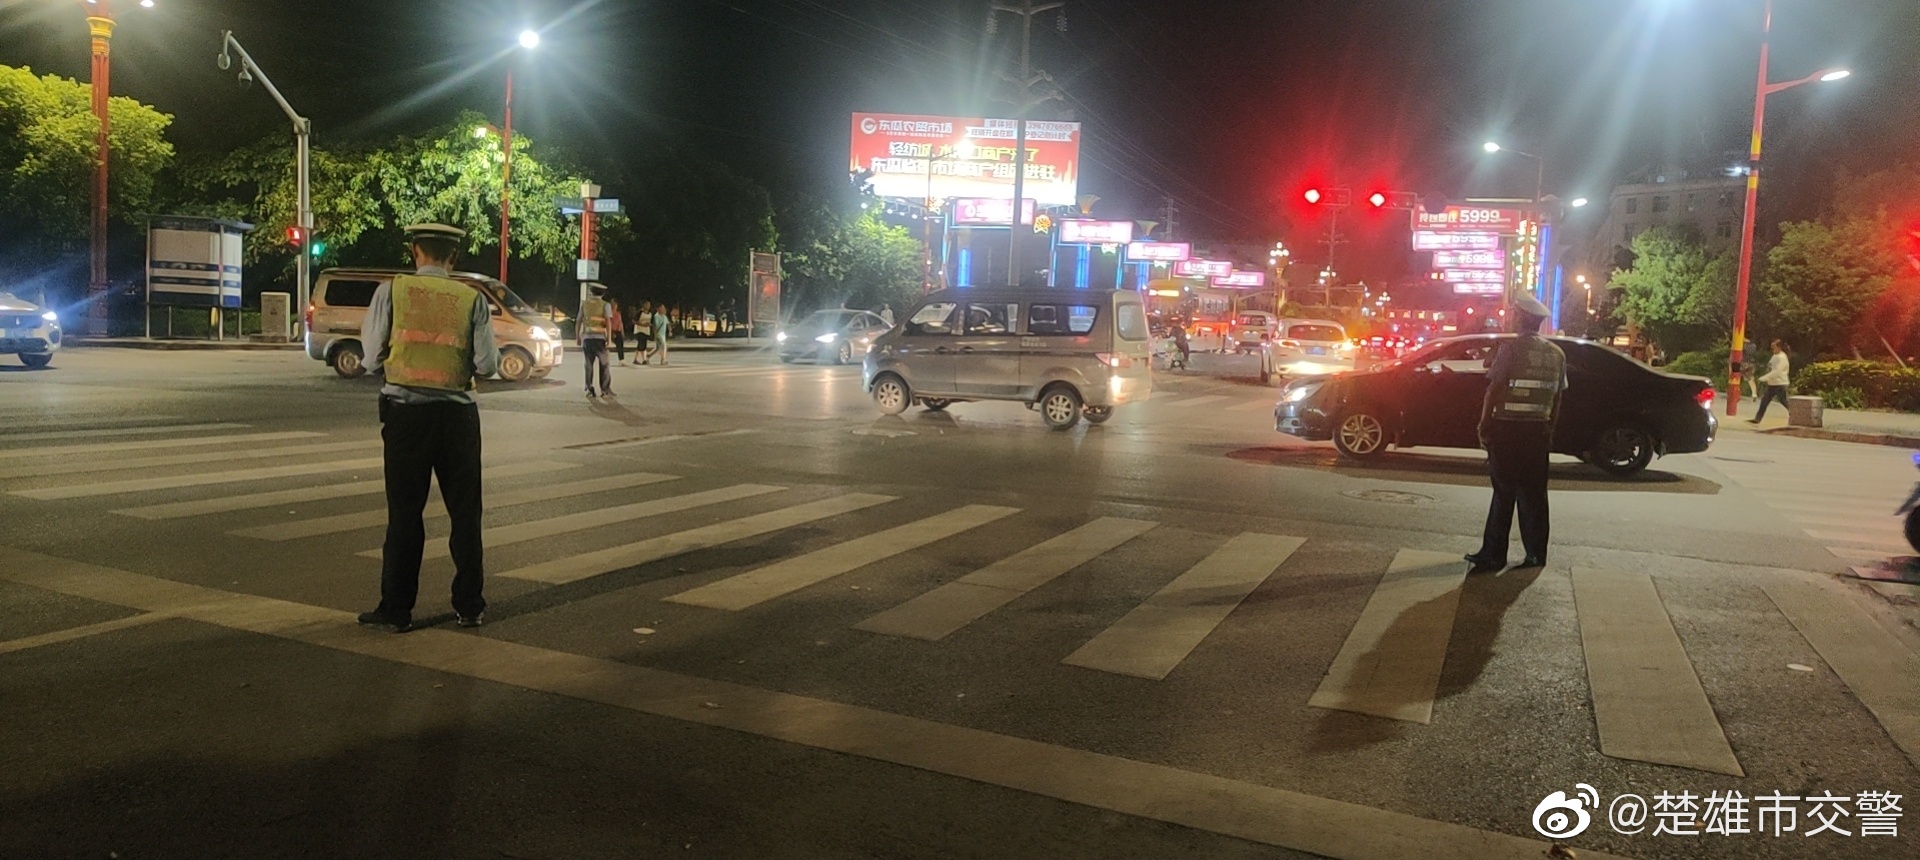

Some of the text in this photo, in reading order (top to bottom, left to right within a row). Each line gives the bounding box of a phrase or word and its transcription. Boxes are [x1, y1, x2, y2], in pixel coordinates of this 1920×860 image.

[879, 120, 953, 134] 东瓜农贸市场
[1459, 209, 1500, 223] 5999
